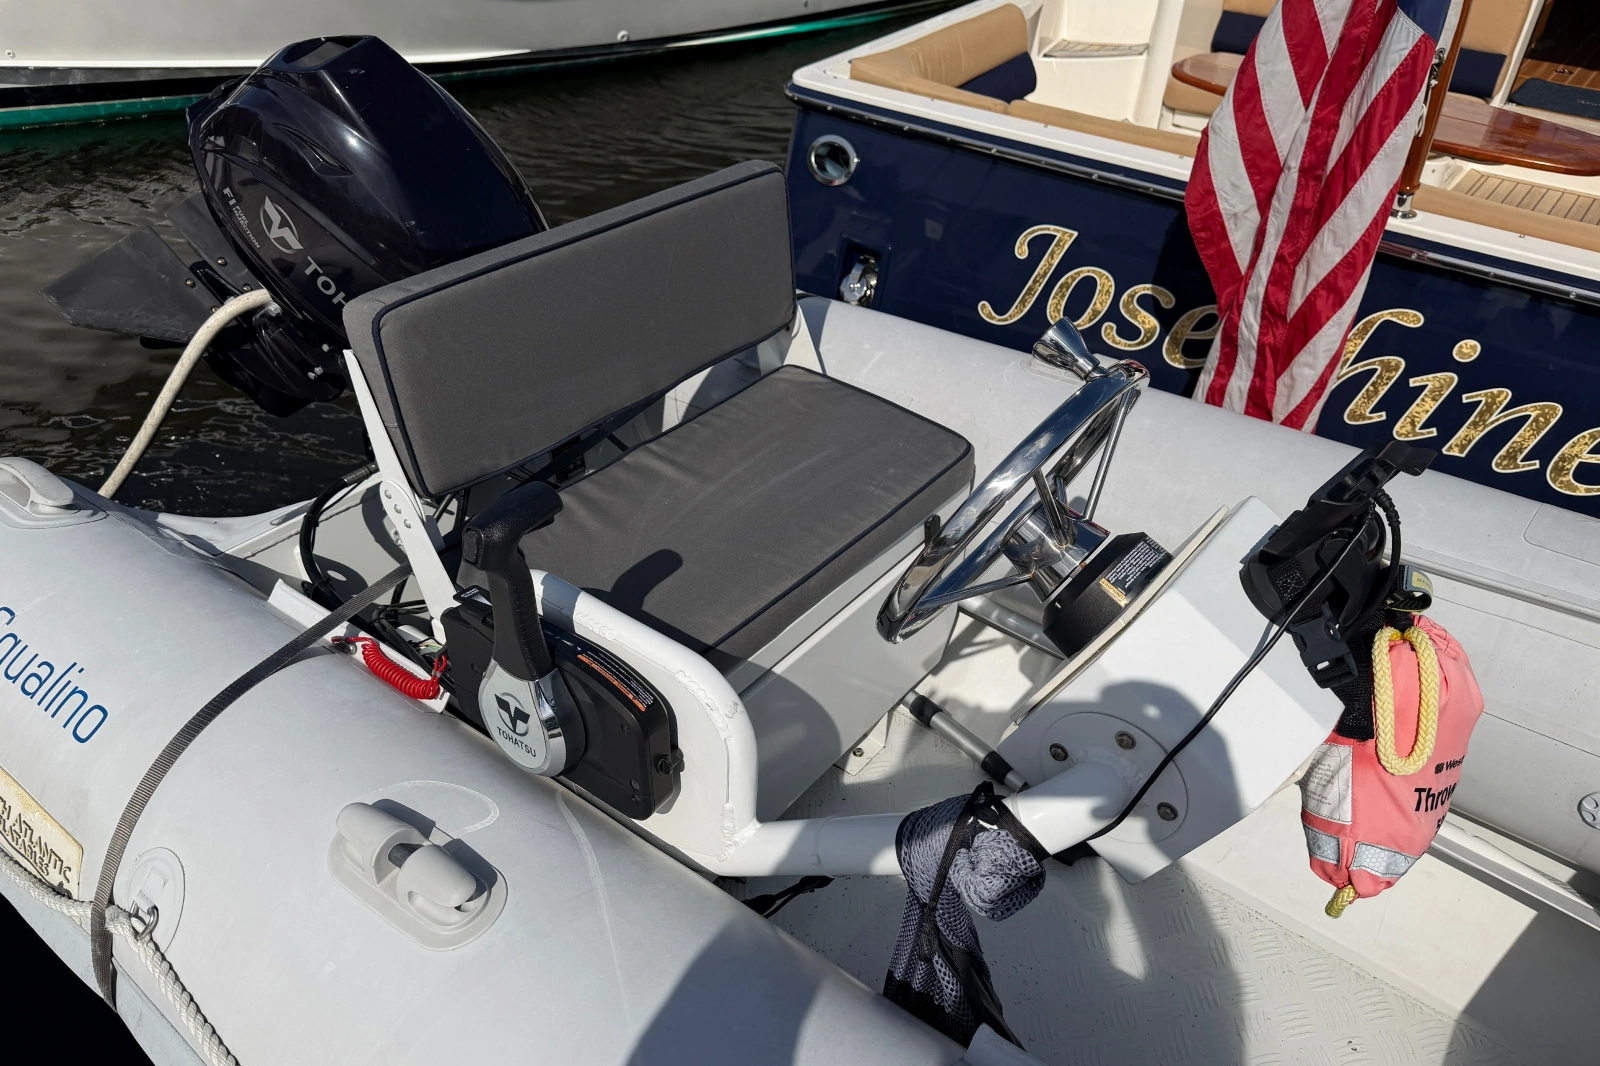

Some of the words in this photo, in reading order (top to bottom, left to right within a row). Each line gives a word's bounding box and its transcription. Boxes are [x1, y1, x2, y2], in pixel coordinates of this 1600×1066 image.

[223, 187, 237, 206] FI
[232, 207, 260, 249] INJECTION
[977, 224, 1600, 496] Josehine
[496, 726, 537, 758] TOHATSU
[12, 812, 72, 884] ATLANTIC
